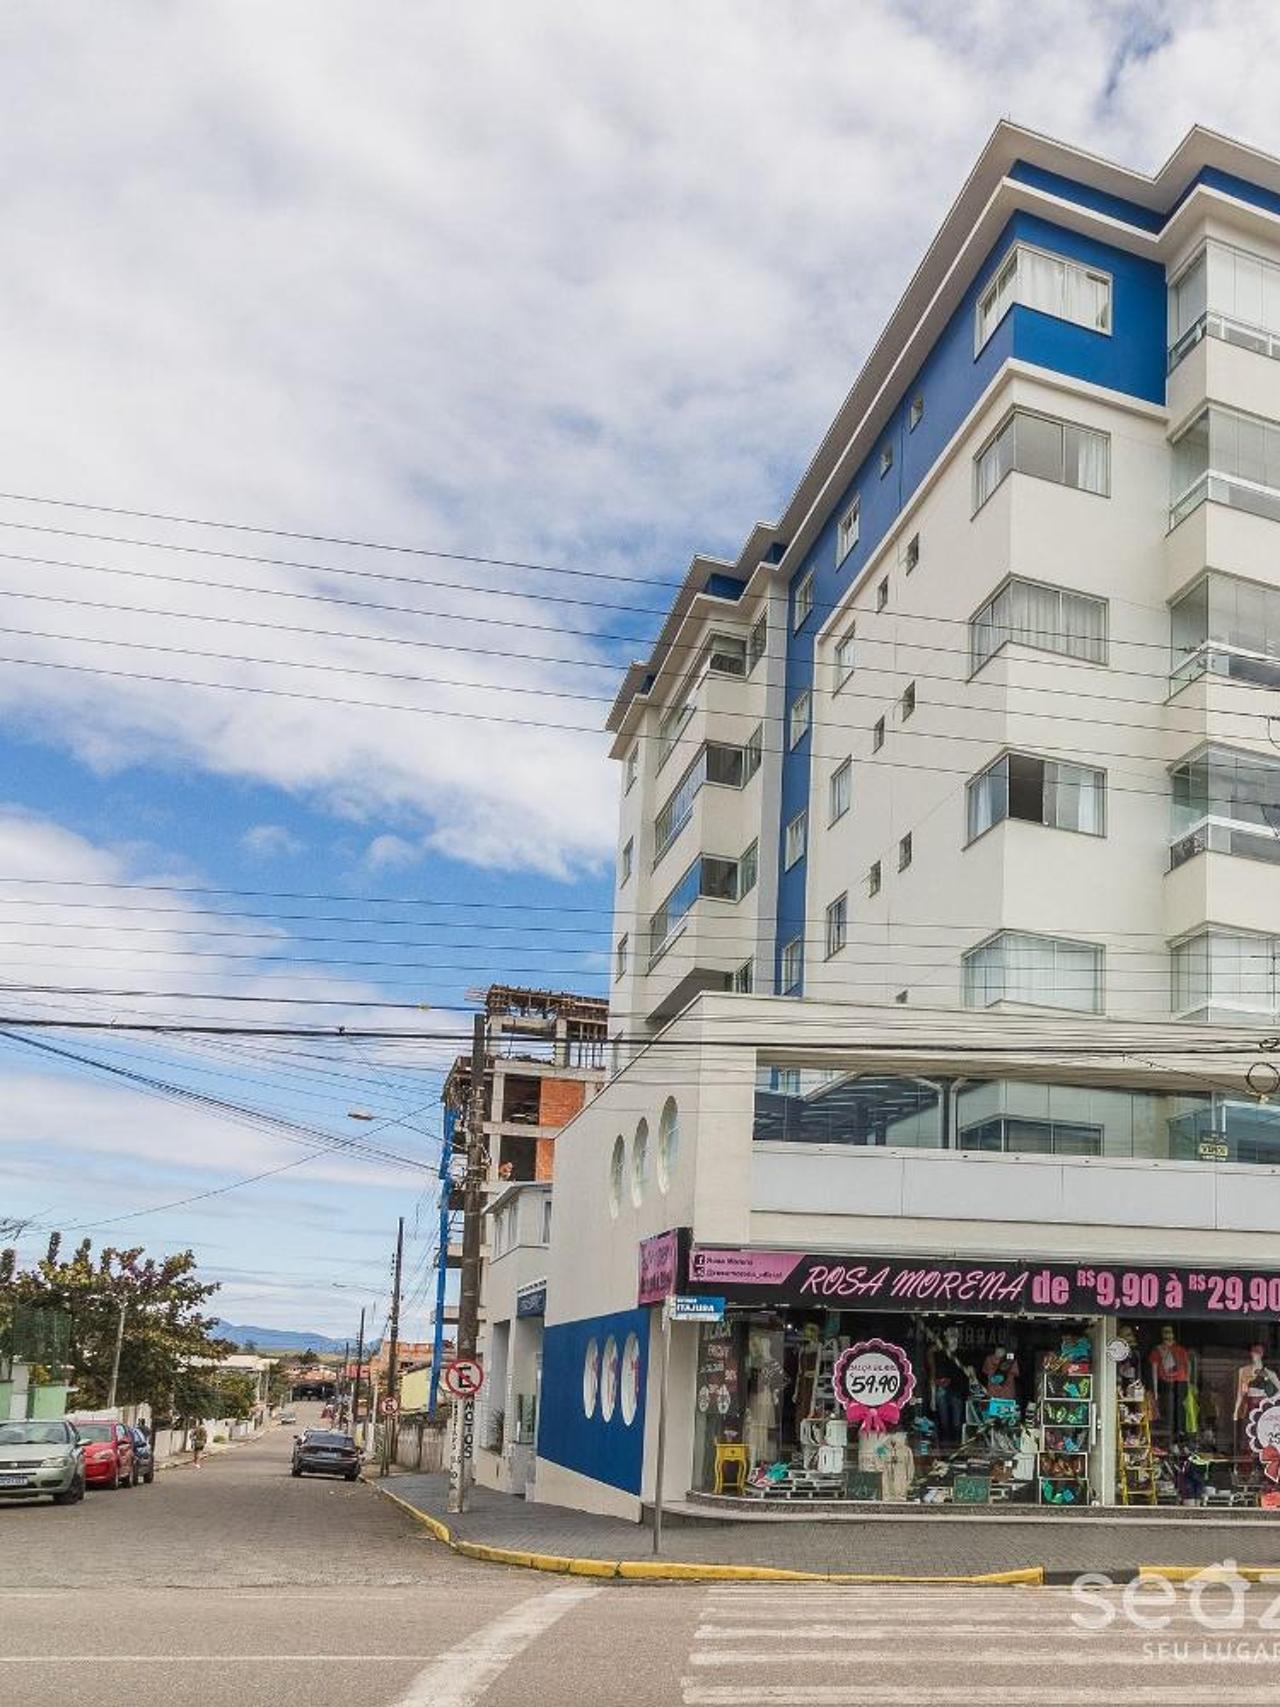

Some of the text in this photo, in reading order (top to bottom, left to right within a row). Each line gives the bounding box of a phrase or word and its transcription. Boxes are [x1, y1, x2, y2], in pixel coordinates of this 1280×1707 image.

[800, 1265, 891, 1295] ROSA
[889, 1268, 1030, 1301] MORENA
[1032, 1270, 1070, 1304] de
